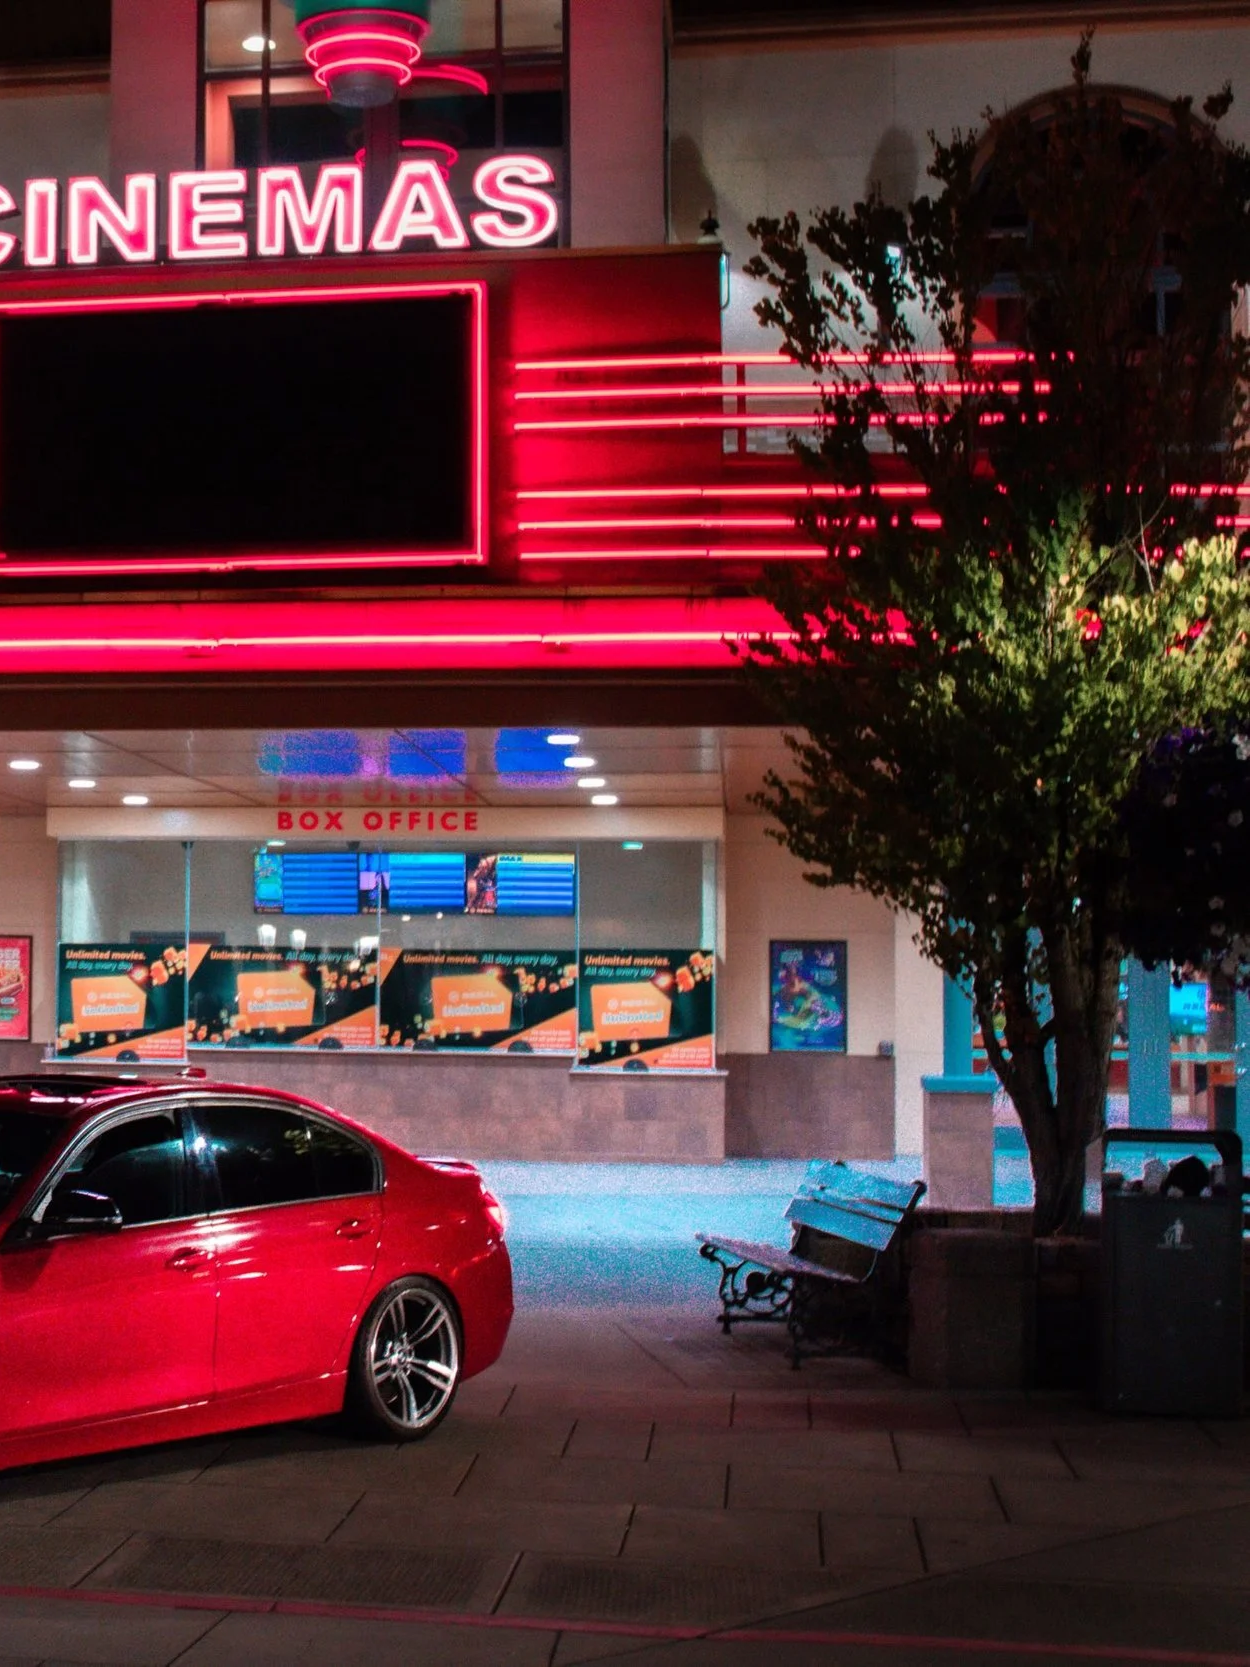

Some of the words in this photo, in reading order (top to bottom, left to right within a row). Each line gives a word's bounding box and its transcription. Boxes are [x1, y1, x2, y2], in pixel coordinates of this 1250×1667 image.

[277, 811, 343, 831] BOX
[363, 811, 478, 831] OFFICE
[65, 950, 111, 960] Unlimited
[111, 950, 146, 961] movies.
[210, 951, 251, 960] Unlimited
[252, 952, 283, 961] movies.
[403, 954, 445, 963] Unlimited
[446, 955, 479, 964] movies.
[514, 955, 539, 967] every
[584, 955, 632, 966] Unlimited
[633, 956, 670, 966] movies.
